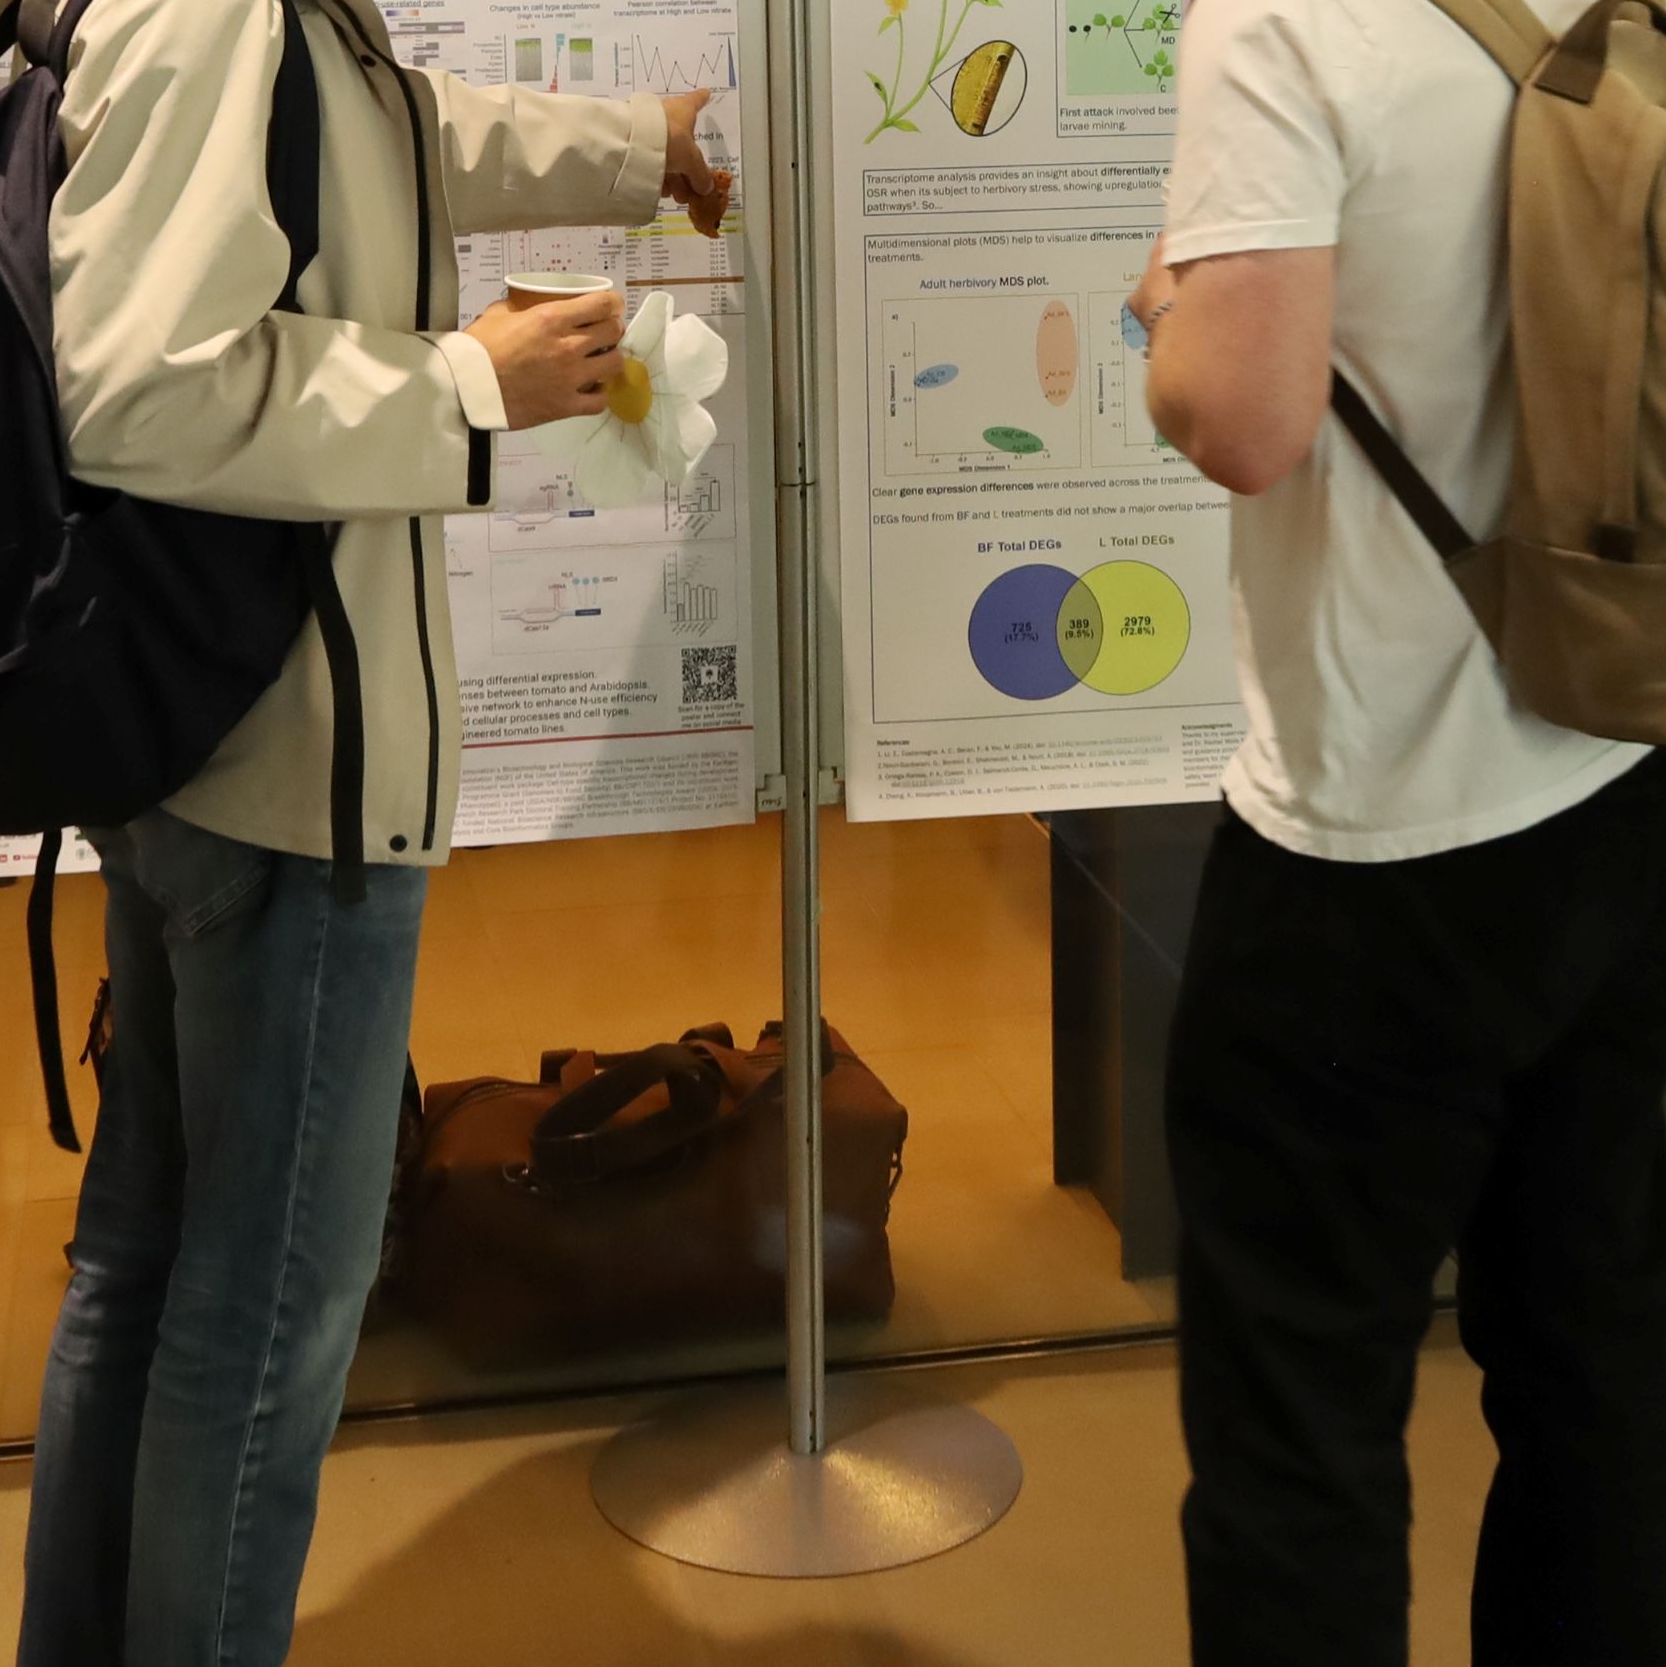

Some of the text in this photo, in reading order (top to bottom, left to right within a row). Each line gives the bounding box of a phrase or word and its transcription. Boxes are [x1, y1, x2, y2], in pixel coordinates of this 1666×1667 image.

[919, 278, 947, 291] Adult
[998, 275, 1025, 288] MDS
[1026, 275, 1050, 289] plot.
[977, 538, 1062, 555] BF Total DEGs
[1098, 533, 1175, 549] L Total DEGs
[1069, 618, 1090, 629] 389
[1123, 615, 1152, 626] 2979
